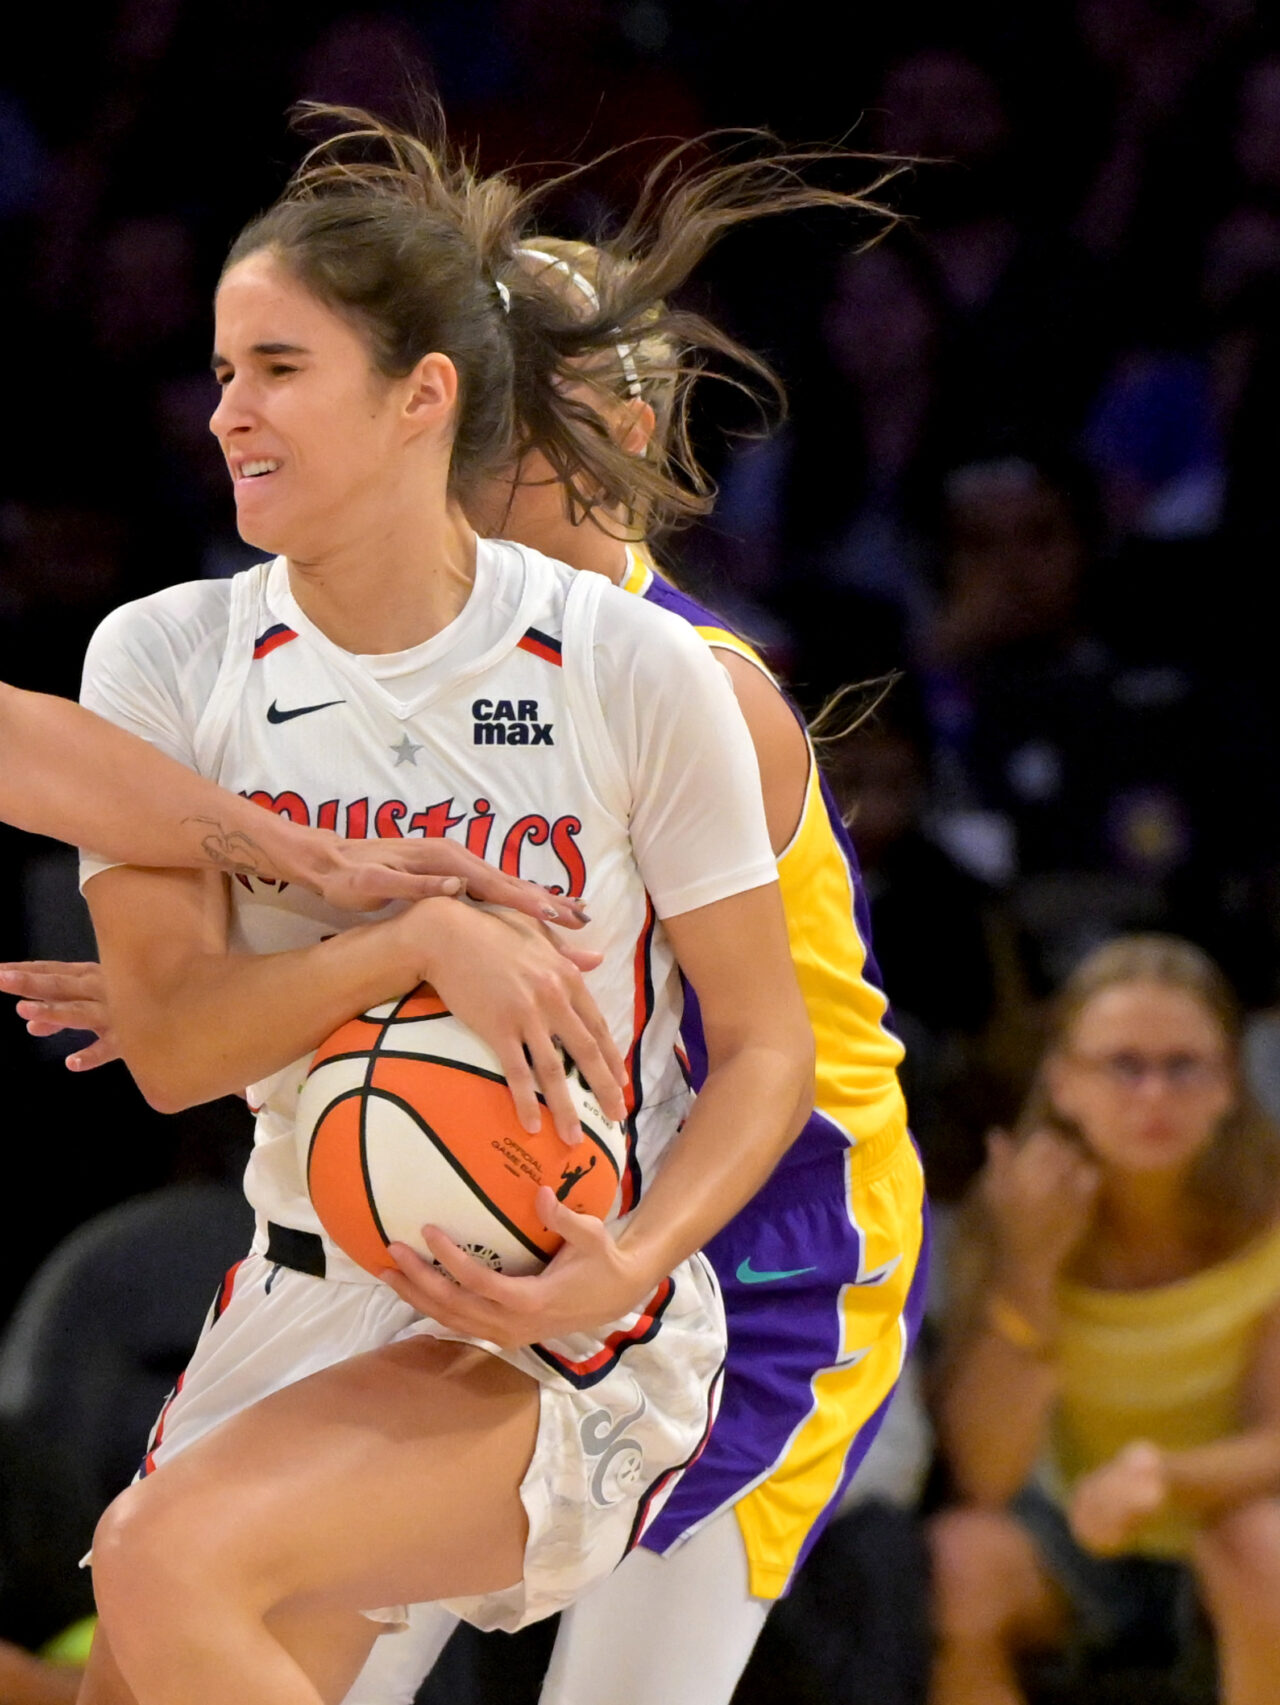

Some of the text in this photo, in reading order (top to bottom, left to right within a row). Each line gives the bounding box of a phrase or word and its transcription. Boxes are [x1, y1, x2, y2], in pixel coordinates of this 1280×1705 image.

[471, 698, 539, 722] CAR
[473, 720, 555, 746] max
[491, 1140, 520, 1166] GAME
[520, 1163, 543, 1186] BALL
[503, 1137, 543, 1174] OFFICIAL
